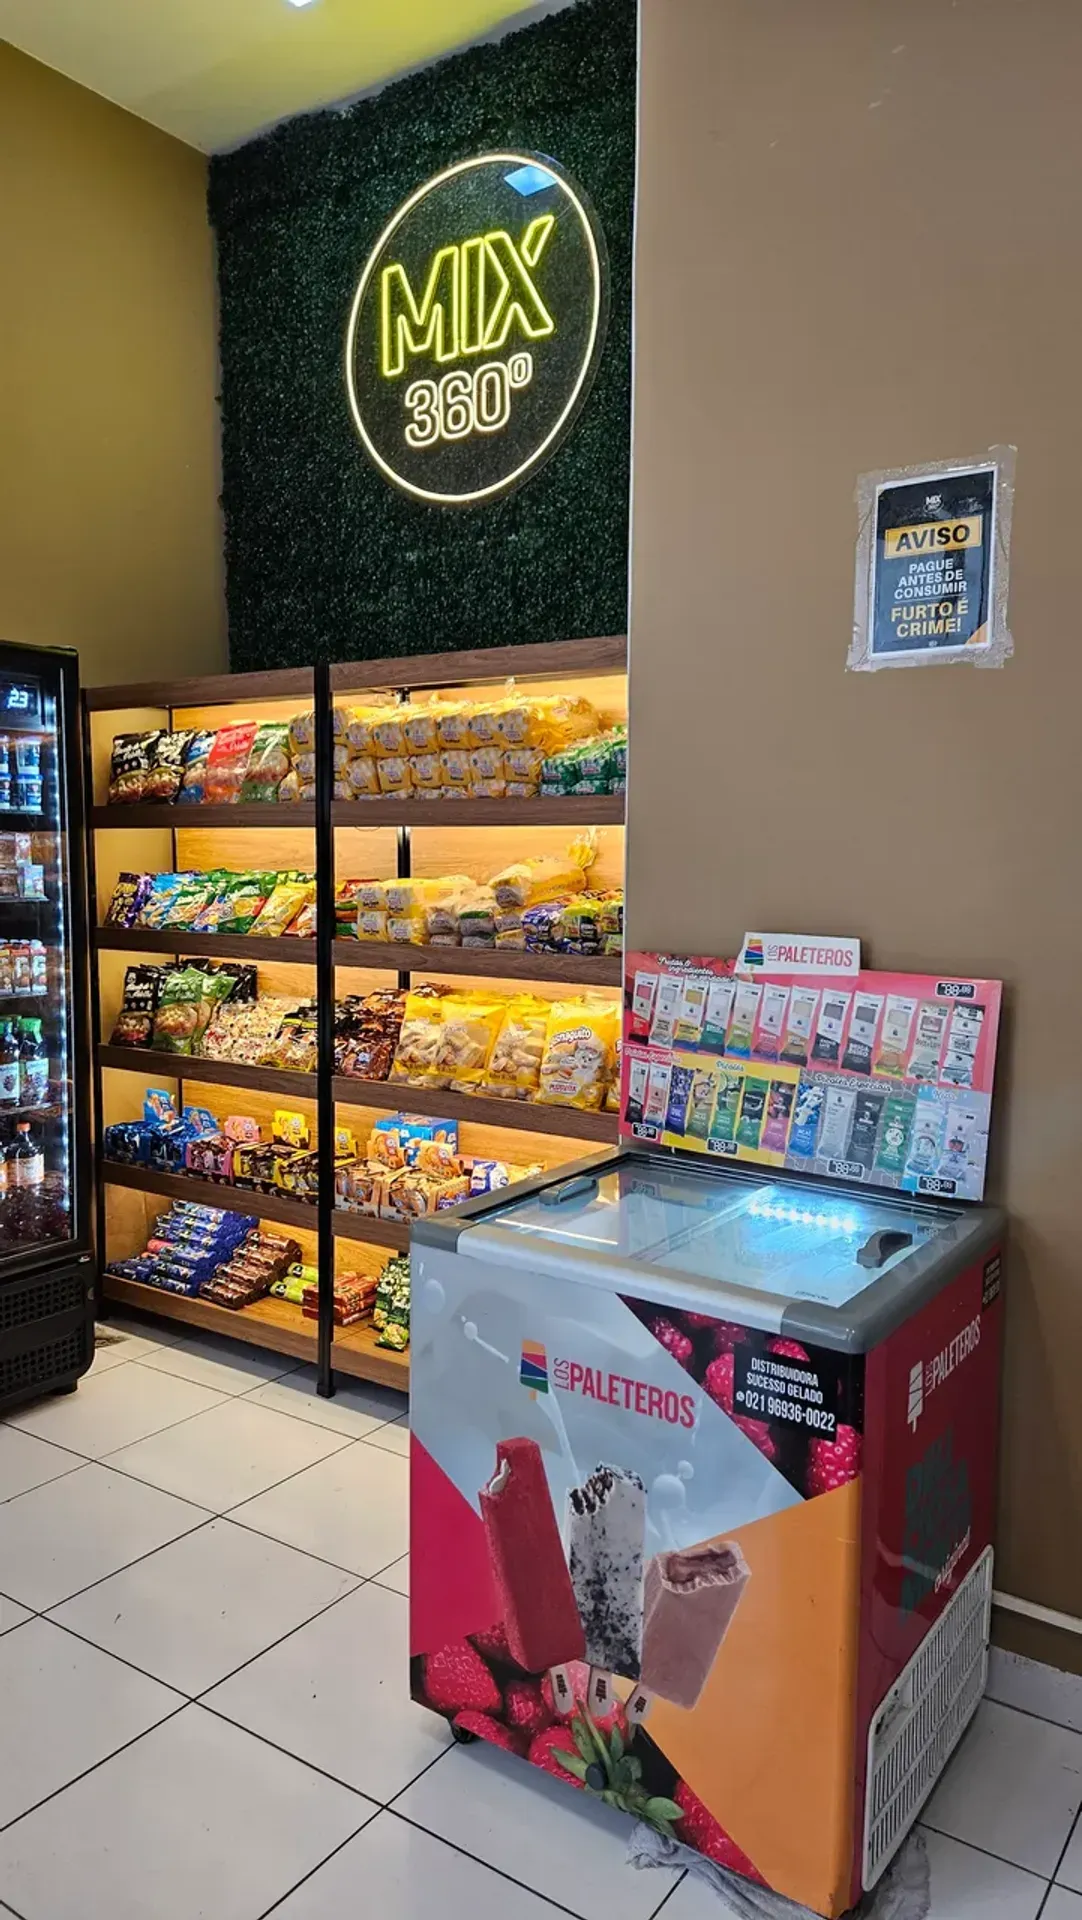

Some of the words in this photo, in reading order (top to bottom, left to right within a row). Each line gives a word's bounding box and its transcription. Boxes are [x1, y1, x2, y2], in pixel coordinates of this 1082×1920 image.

[382, 214, 555, 378] MIX
[895, 525, 970, 552] AVISO
[898, 572, 942, 588] ANTES
[944, 569, 964, 582] DE
[909, 558, 953, 574] PAGUE
[893, 581, 968, 600] CONSUMIR
[891, 601, 953, 622] FURTO
[957, 597, 969, 614] É
[896, 617, 962, 638] CRIME!
[767, 944, 778, 961] LOS
[778, 945, 854, 967] PALETEROS
[932, 1314, 981, 1389] PALETEROS
[751, 1357, 819, 1387] DISTRIBUIDORA
[553, 1356, 571, 1391] LOS
[570, 1360, 695, 1429] PALETEROS
[746, 1372, 786, 1394] SUCESSO
[787, 1383, 823, 1404] GELADO
[745, 1390, 765, 1412] 021
[767, 1396, 835, 1432] 96936-0022
